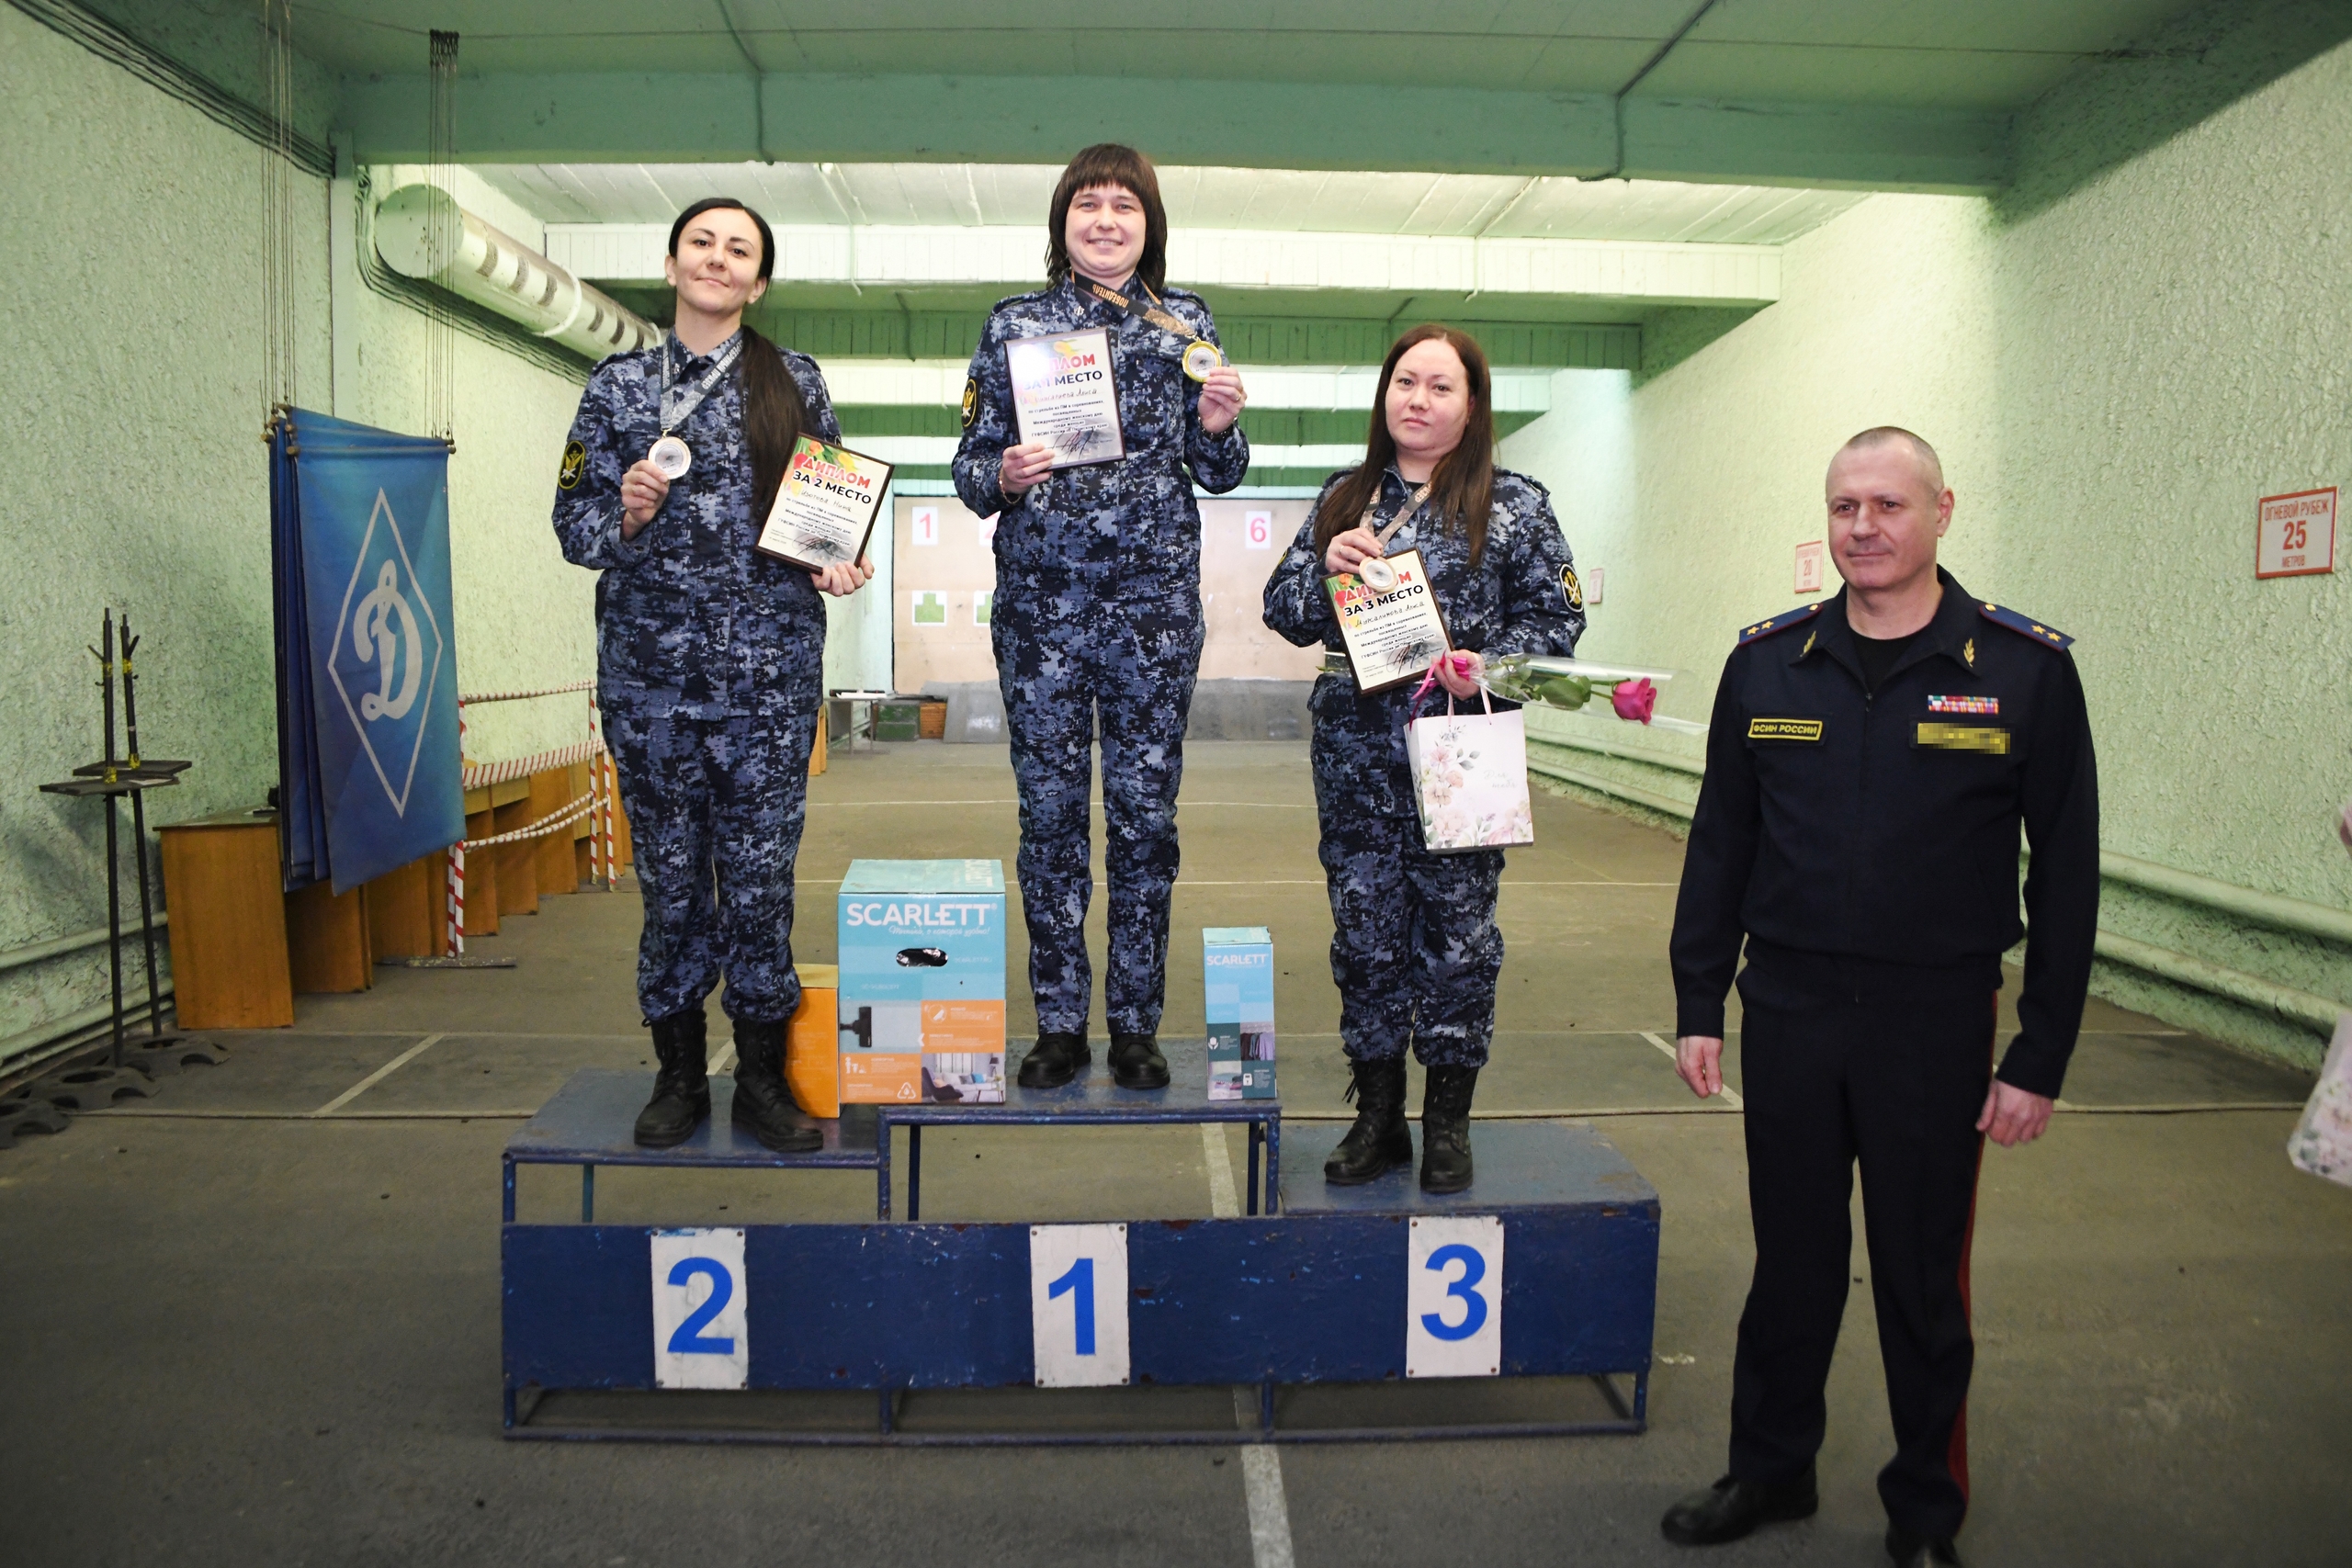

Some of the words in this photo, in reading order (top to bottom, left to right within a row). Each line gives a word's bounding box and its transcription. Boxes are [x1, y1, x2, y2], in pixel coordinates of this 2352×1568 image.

[1092, 283, 1129, 308] ПОБЕДИТЕЛЬ
[701, 368, 721, 389] ПРИЗЕР
[1023, 380, 1042, 390] ЗА
[1055, 370, 1102, 386] МЕСТО
[803, 457, 870, 489] ДИПЛОМ
[793, 470, 810, 484] ЗА
[814, 478, 822, 488] 2
[825, 481, 872, 504] МЕСТО
[2265, 501, 2299, 521] ОГНЕВОЙ
[2301, 499, 2329, 516] РУБЕЖ
[920, 513, 931, 538] 1
[1250, 517, 1266, 542] 6
[2282, 520, 2307, 550] 25
[2282, 555, 2305, 568] МЕТРОВ
[1344, 605, 1363, 616] ЗА
[1365, 600, 1374, 610] 3
[1377, 584, 1423, 606] МЕСТО
[1753, 724, 1778, 733] ФСИН
[1779, 725, 1817, 734] РОССИИ
[846, 903, 990, 927] SCARLETT
[1206, 953, 1267, 965] SCARLETT
[1420, 1244, 1487, 1341] 3
[667, 1257, 734, 1355] 2
[1048, 1258, 1096, 1356] 1
